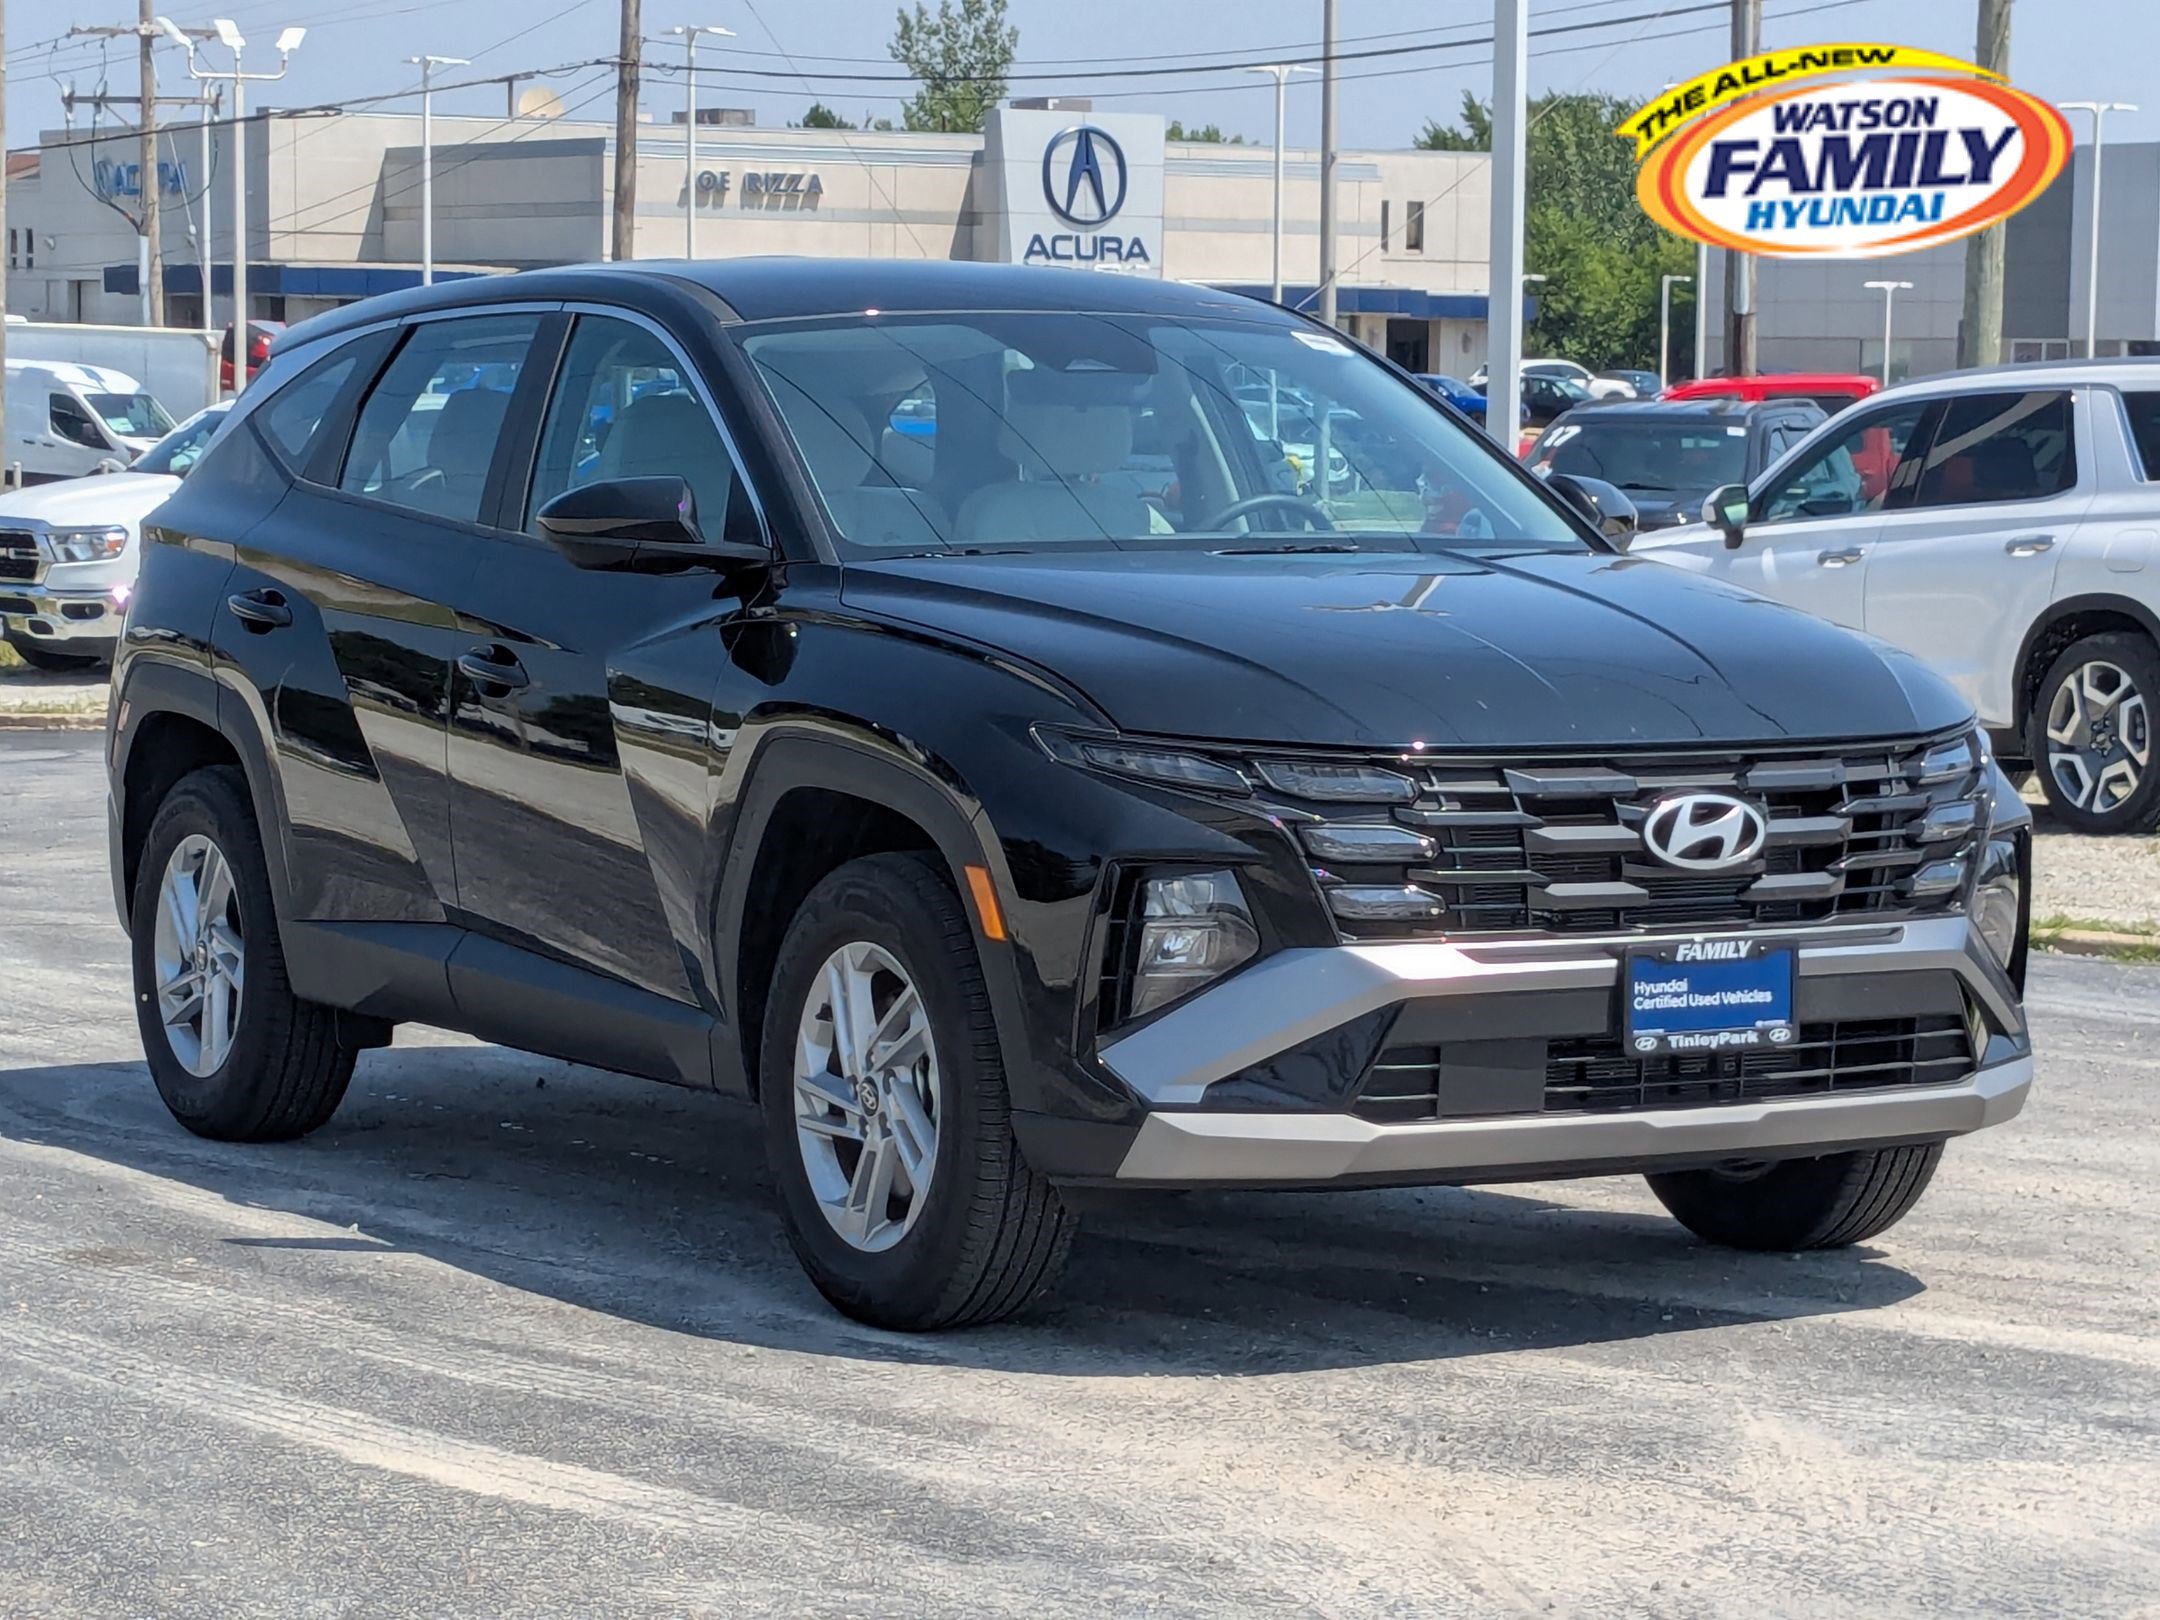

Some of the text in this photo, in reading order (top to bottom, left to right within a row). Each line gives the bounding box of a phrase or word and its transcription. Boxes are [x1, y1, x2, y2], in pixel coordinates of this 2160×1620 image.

[742, 171, 823, 194] RIZZA
[1023, 233, 1150, 263] ACURA
[1676, 940, 1752, 961] FAMILY
[1634, 978, 1688, 996] Hyundai
[1634, 989, 1773, 1010] Certified Used Vehicles
